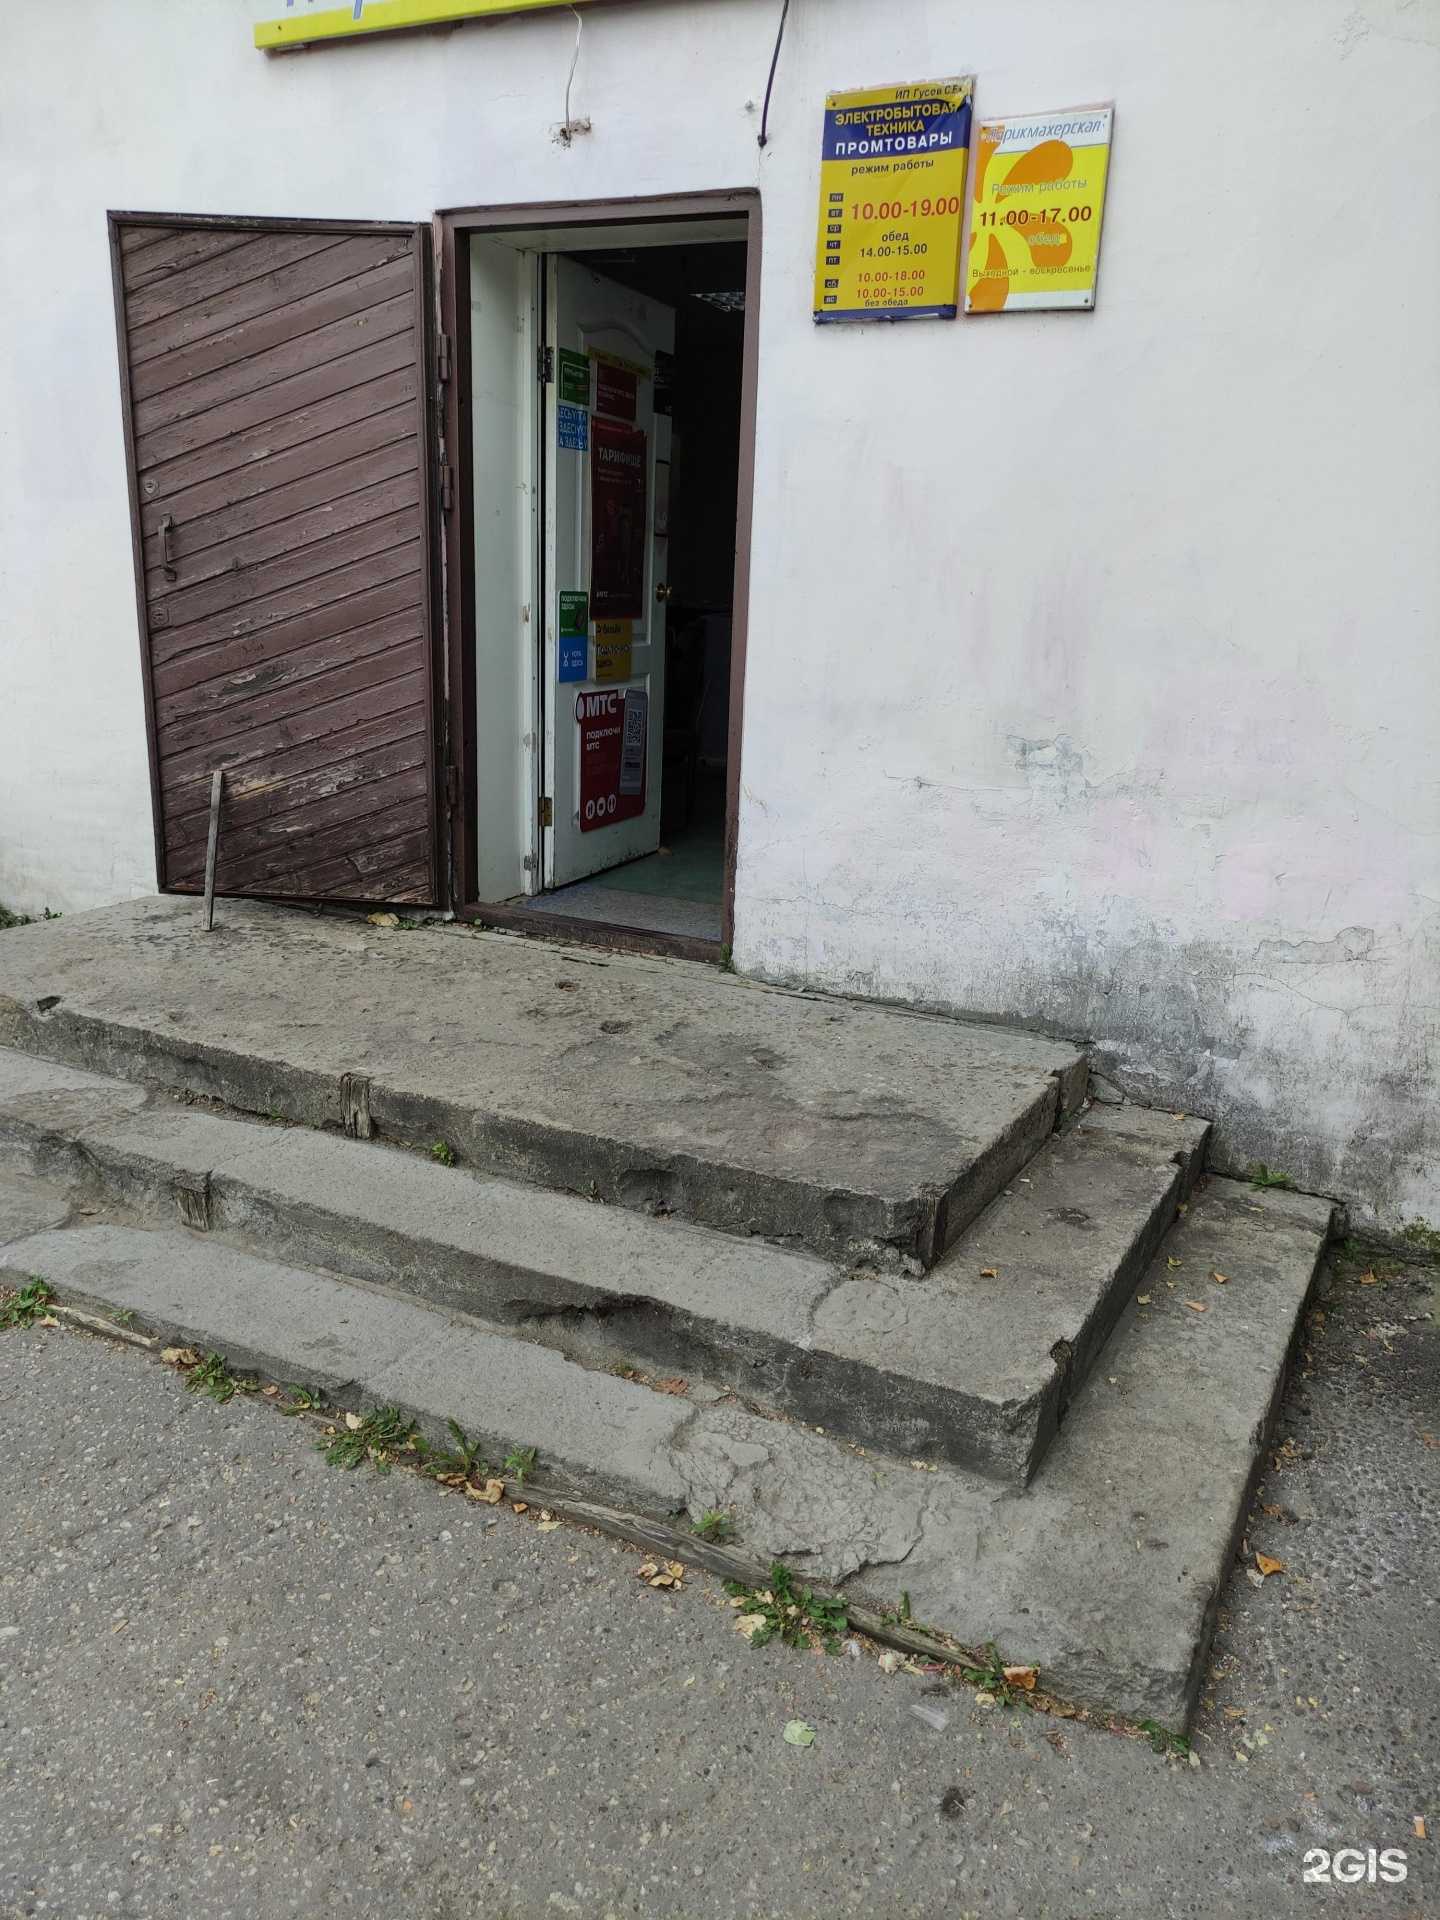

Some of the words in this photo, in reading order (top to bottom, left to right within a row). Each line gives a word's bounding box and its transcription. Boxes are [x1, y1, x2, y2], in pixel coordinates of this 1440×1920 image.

[895, 88, 910, 99] ИП
[834, 102, 958, 126] ЭЛЕКТРОБЫТОВАЯ
[866, 119, 925, 137] ТЕХНИКА
[835, 131, 953, 156] ПРОМТОВАРЫ
[851, 164, 890, 176] режим
[893, 159, 934, 173] работы
[851, 196, 960, 221] 10.00-19.00
[980, 206, 1092, 227] 11.00-17.00
[881, 230, 910, 242] обед
[859, 243, 928, 258] 14.00-15.00
[858, 269, 925, 283] 10.00-18.00
[856, 286, 924, 299] 10.00-15.00
[586, 692, 617, 719] МТС
